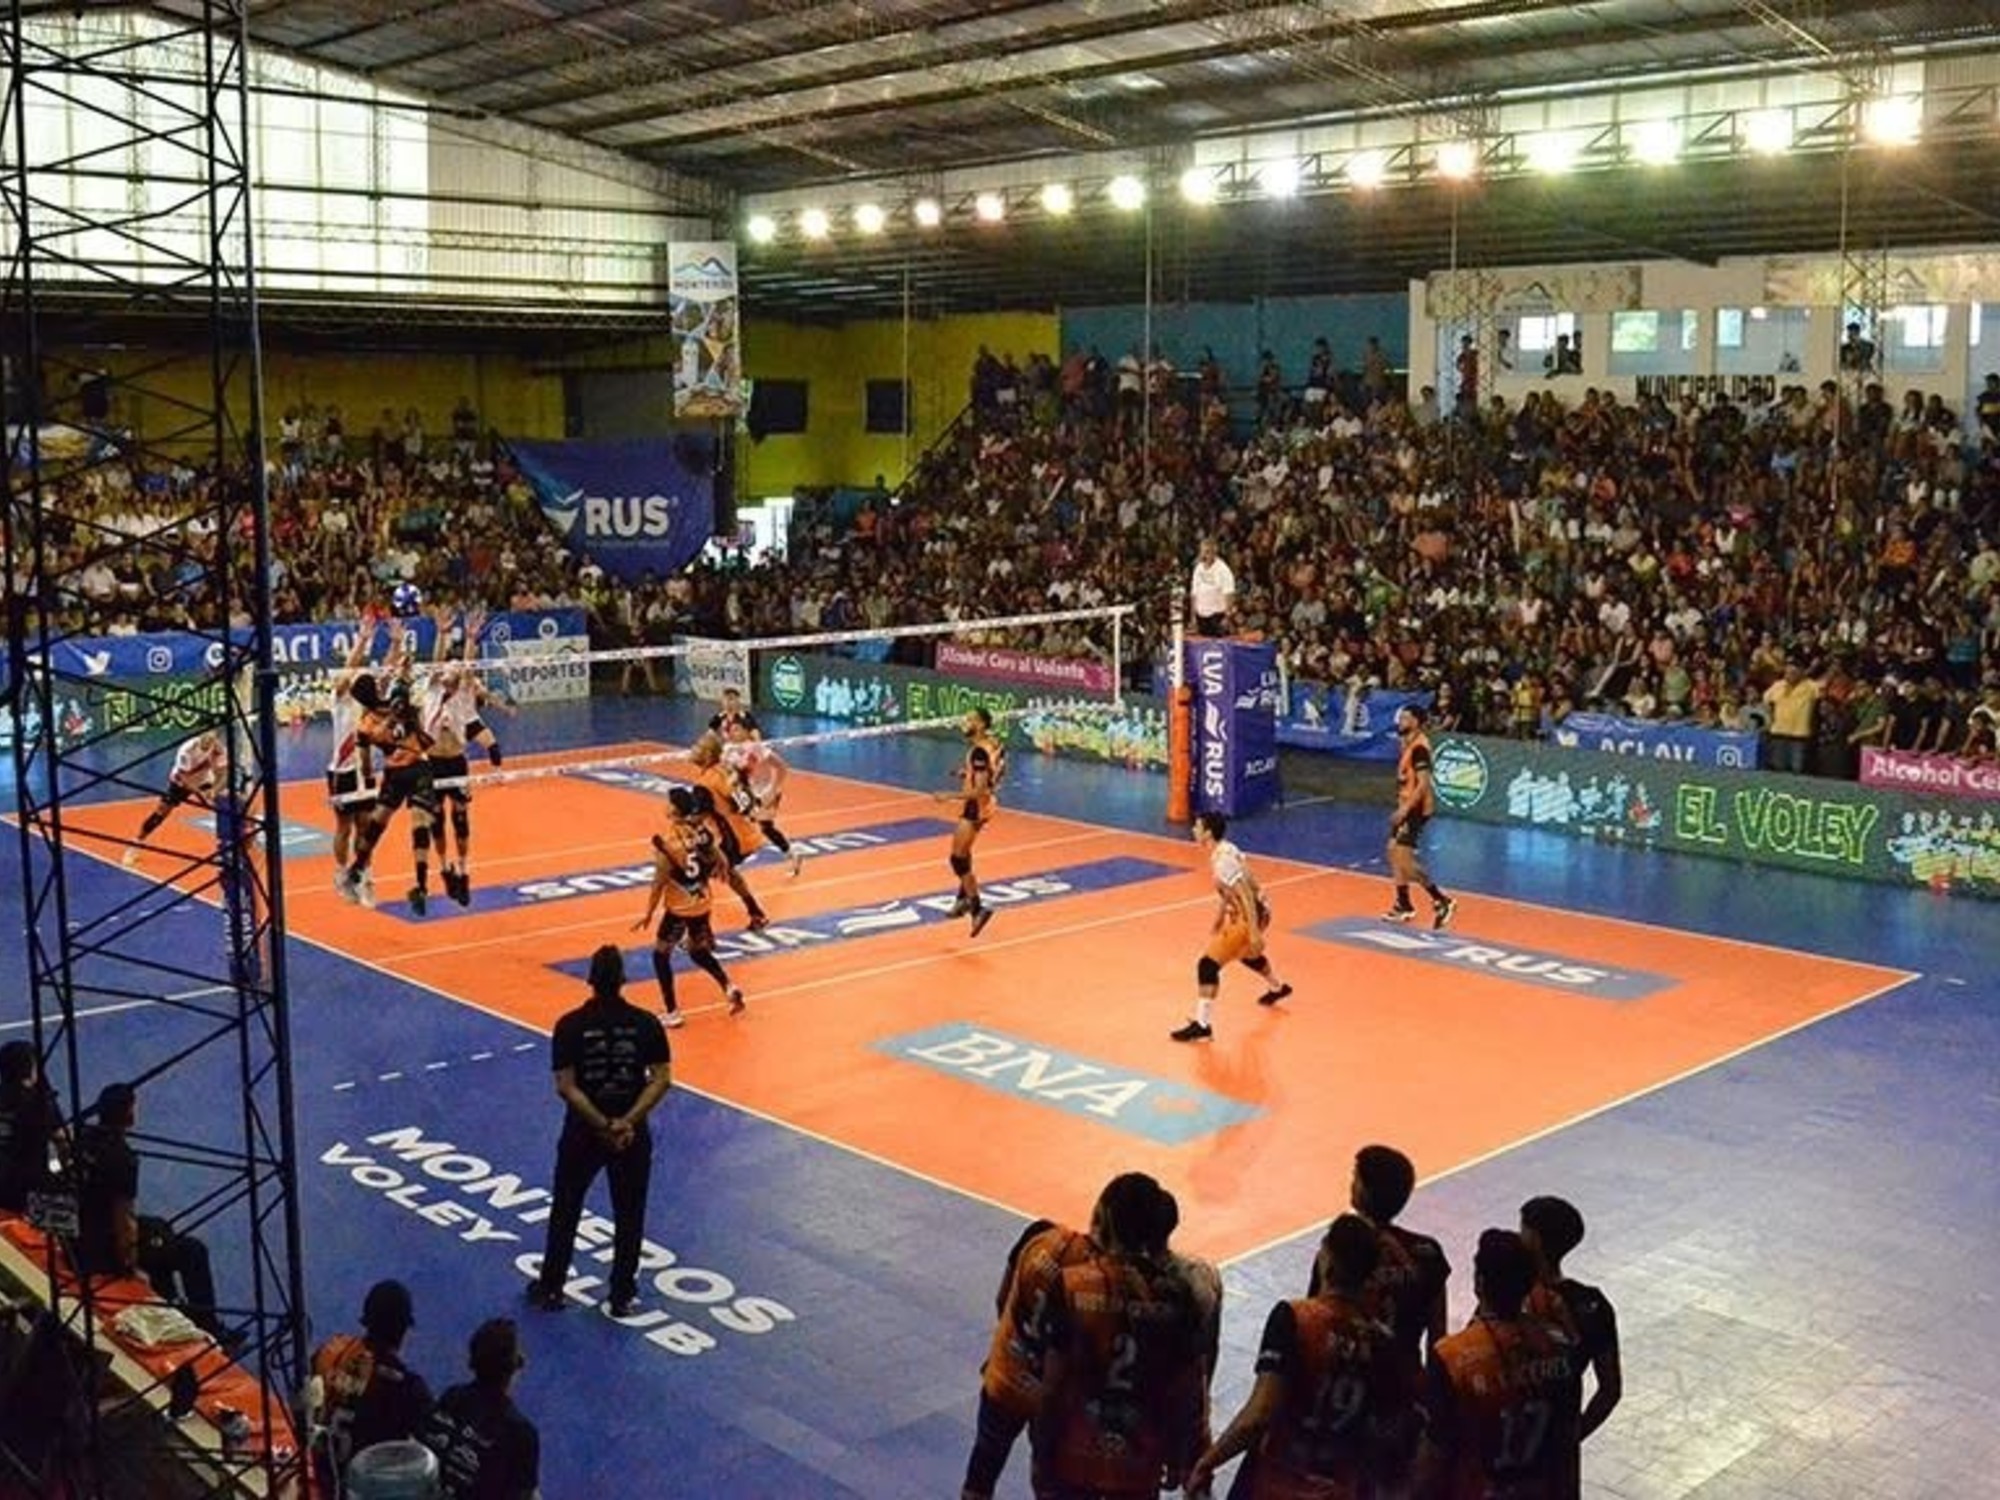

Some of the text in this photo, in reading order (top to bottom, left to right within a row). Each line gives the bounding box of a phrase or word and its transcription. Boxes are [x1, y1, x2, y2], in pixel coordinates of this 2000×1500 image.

[584, 494, 670, 537] RUS
[510, 662, 588, 686] DEPORTES
[941, 646, 986, 668] Alcohol
[1033, 659, 1085, 679] Volante
[1202, 652, 1225, 797] LVA RUS
[1870, 753, 1961, 786] Alcohol
[1675, 783, 1879, 864] EL VOLEY
[683, 853, 701, 879] 5
[1444, 944, 1609, 984] RUS
[906, 1032, 1149, 1118] BNA
[319, 1142, 521, 1243] VOLEY
[1106, 1333, 1137, 1391] 2
